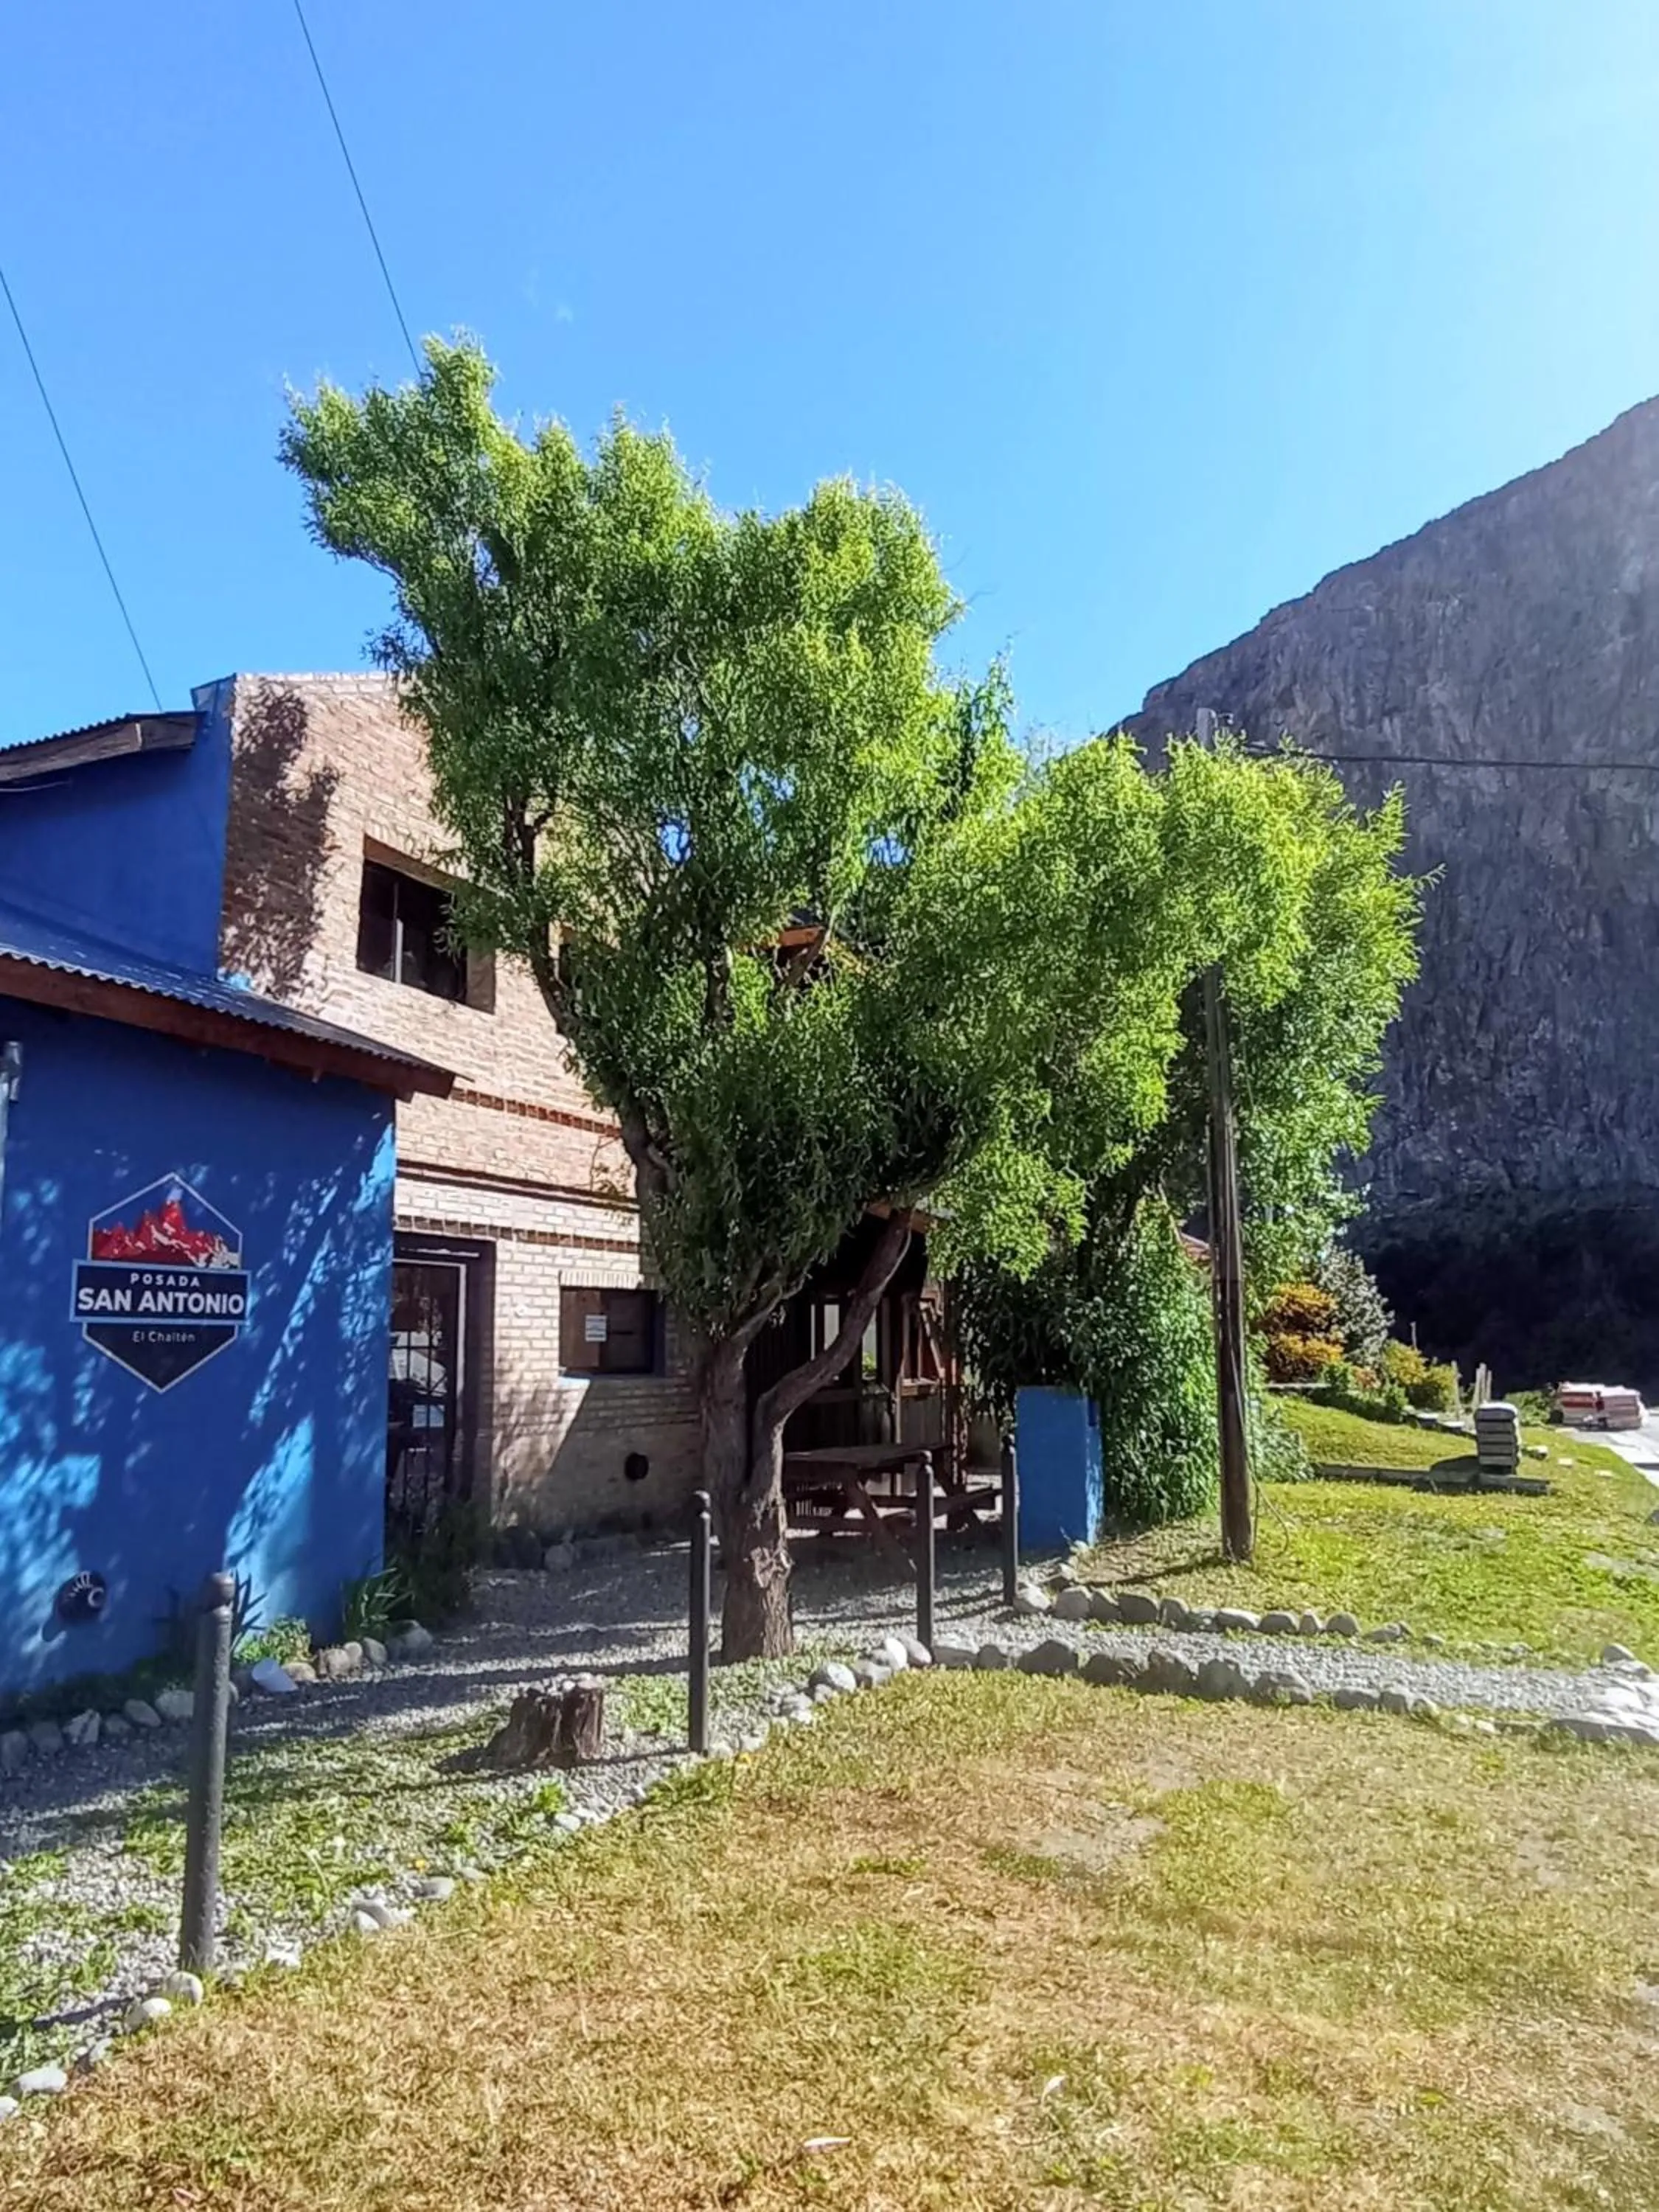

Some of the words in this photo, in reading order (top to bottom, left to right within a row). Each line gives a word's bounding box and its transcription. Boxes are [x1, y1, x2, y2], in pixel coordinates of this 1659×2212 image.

[130, 1272, 201, 1287] POSADA
[77, 1287, 132, 1312] SAN
[138, 1290, 244, 1315] ANTONIO
[133, 1330, 145, 1343] El
